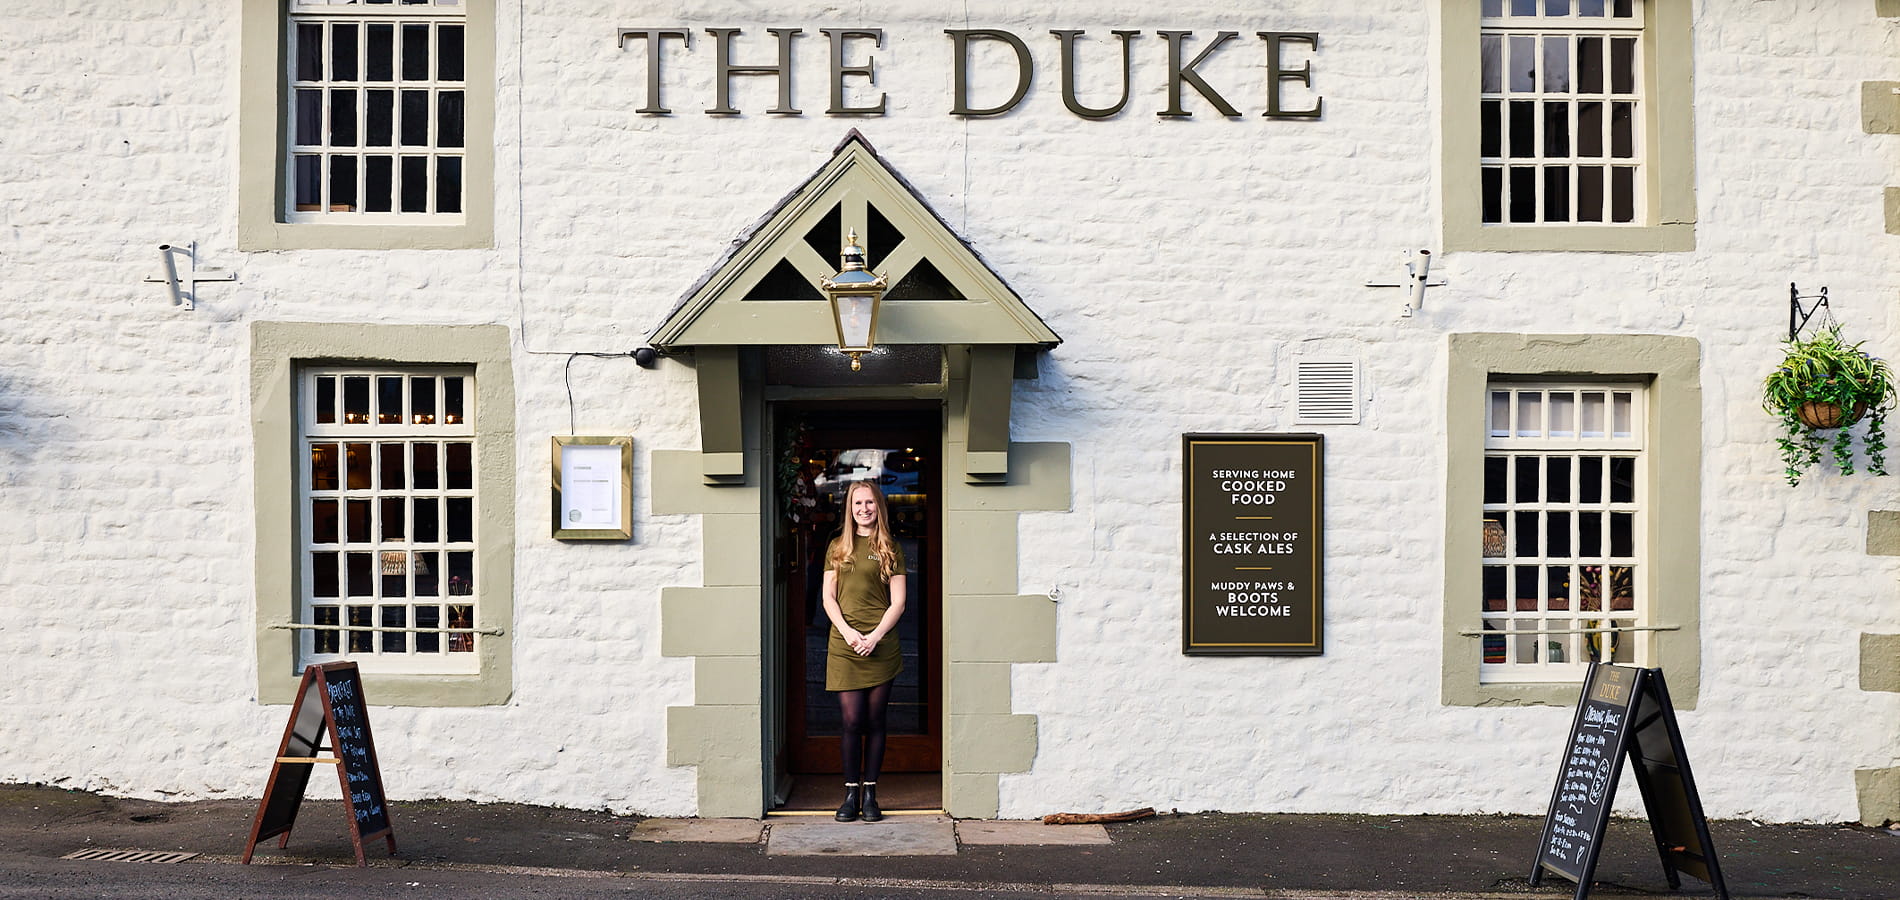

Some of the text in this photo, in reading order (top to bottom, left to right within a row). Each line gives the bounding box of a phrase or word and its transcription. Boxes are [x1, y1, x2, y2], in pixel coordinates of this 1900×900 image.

[617, 27, 1323, 119] THE DUKE
[1212, 469, 1295, 479] SERVING HOME
[1221, 480, 1286, 492] COOKED
[1231, 493, 1275, 505] FOOD
[1209, 532, 1298, 541] A SELECTION OF
[1213, 543, 1294, 554] CASK ALES
[1211, 581, 1295, 591] MUDDY PAWS &
[1228, 592, 1278, 604] BOOTS
[1215, 605, 1291, 617] WELCOME
[1610, 670, 1620, 682] THE
[1600, 683, 1621, 700] DUKE
